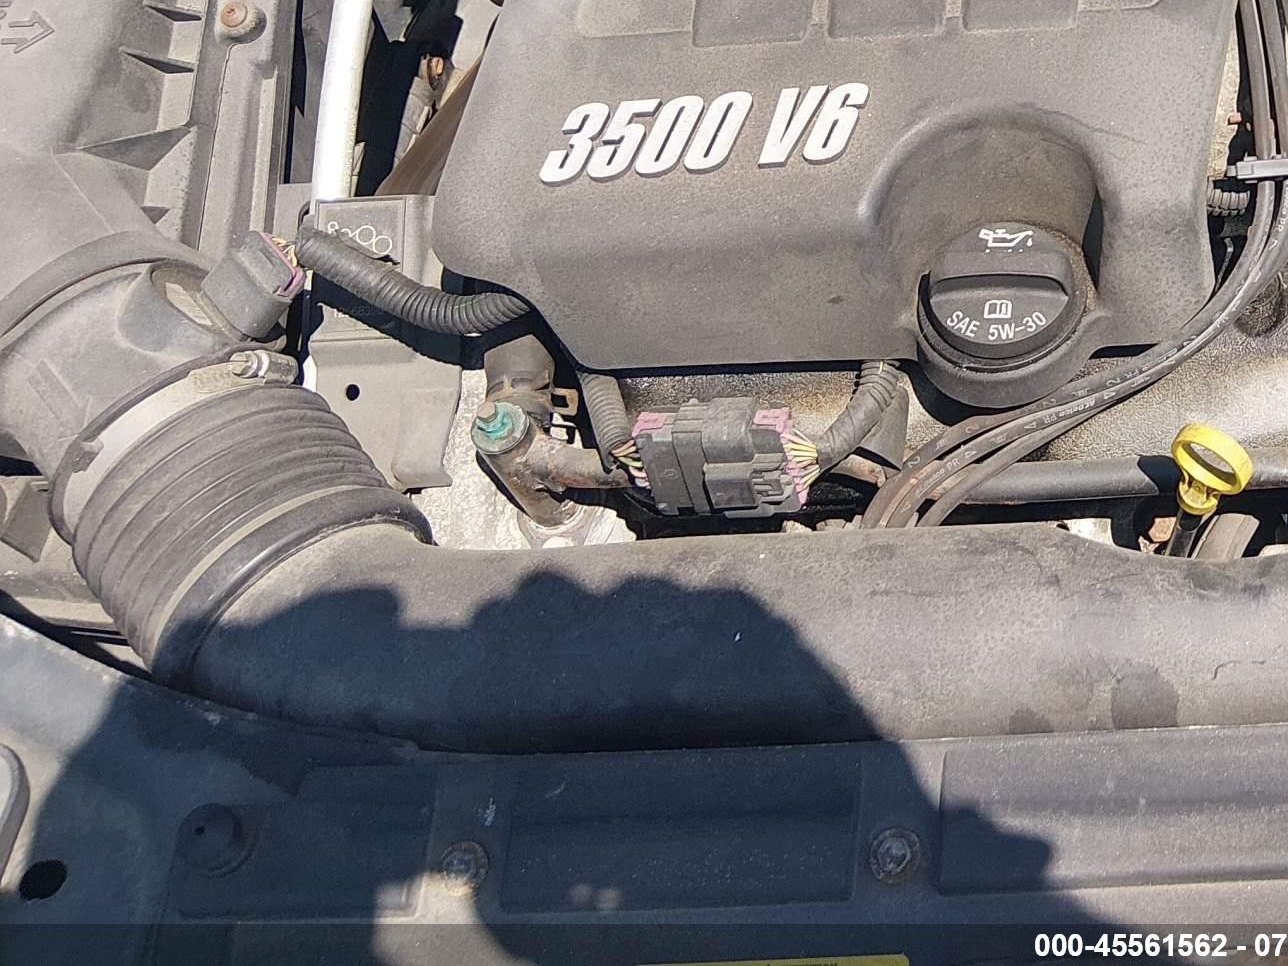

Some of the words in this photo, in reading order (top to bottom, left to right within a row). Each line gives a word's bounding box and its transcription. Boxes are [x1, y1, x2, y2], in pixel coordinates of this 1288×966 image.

[539, 90, 754, 187] 3500
[757, 82, 870, 170] V6
[946, 310, 981, 338] SAE
[987, 311, 1047, 341] 5W-30
